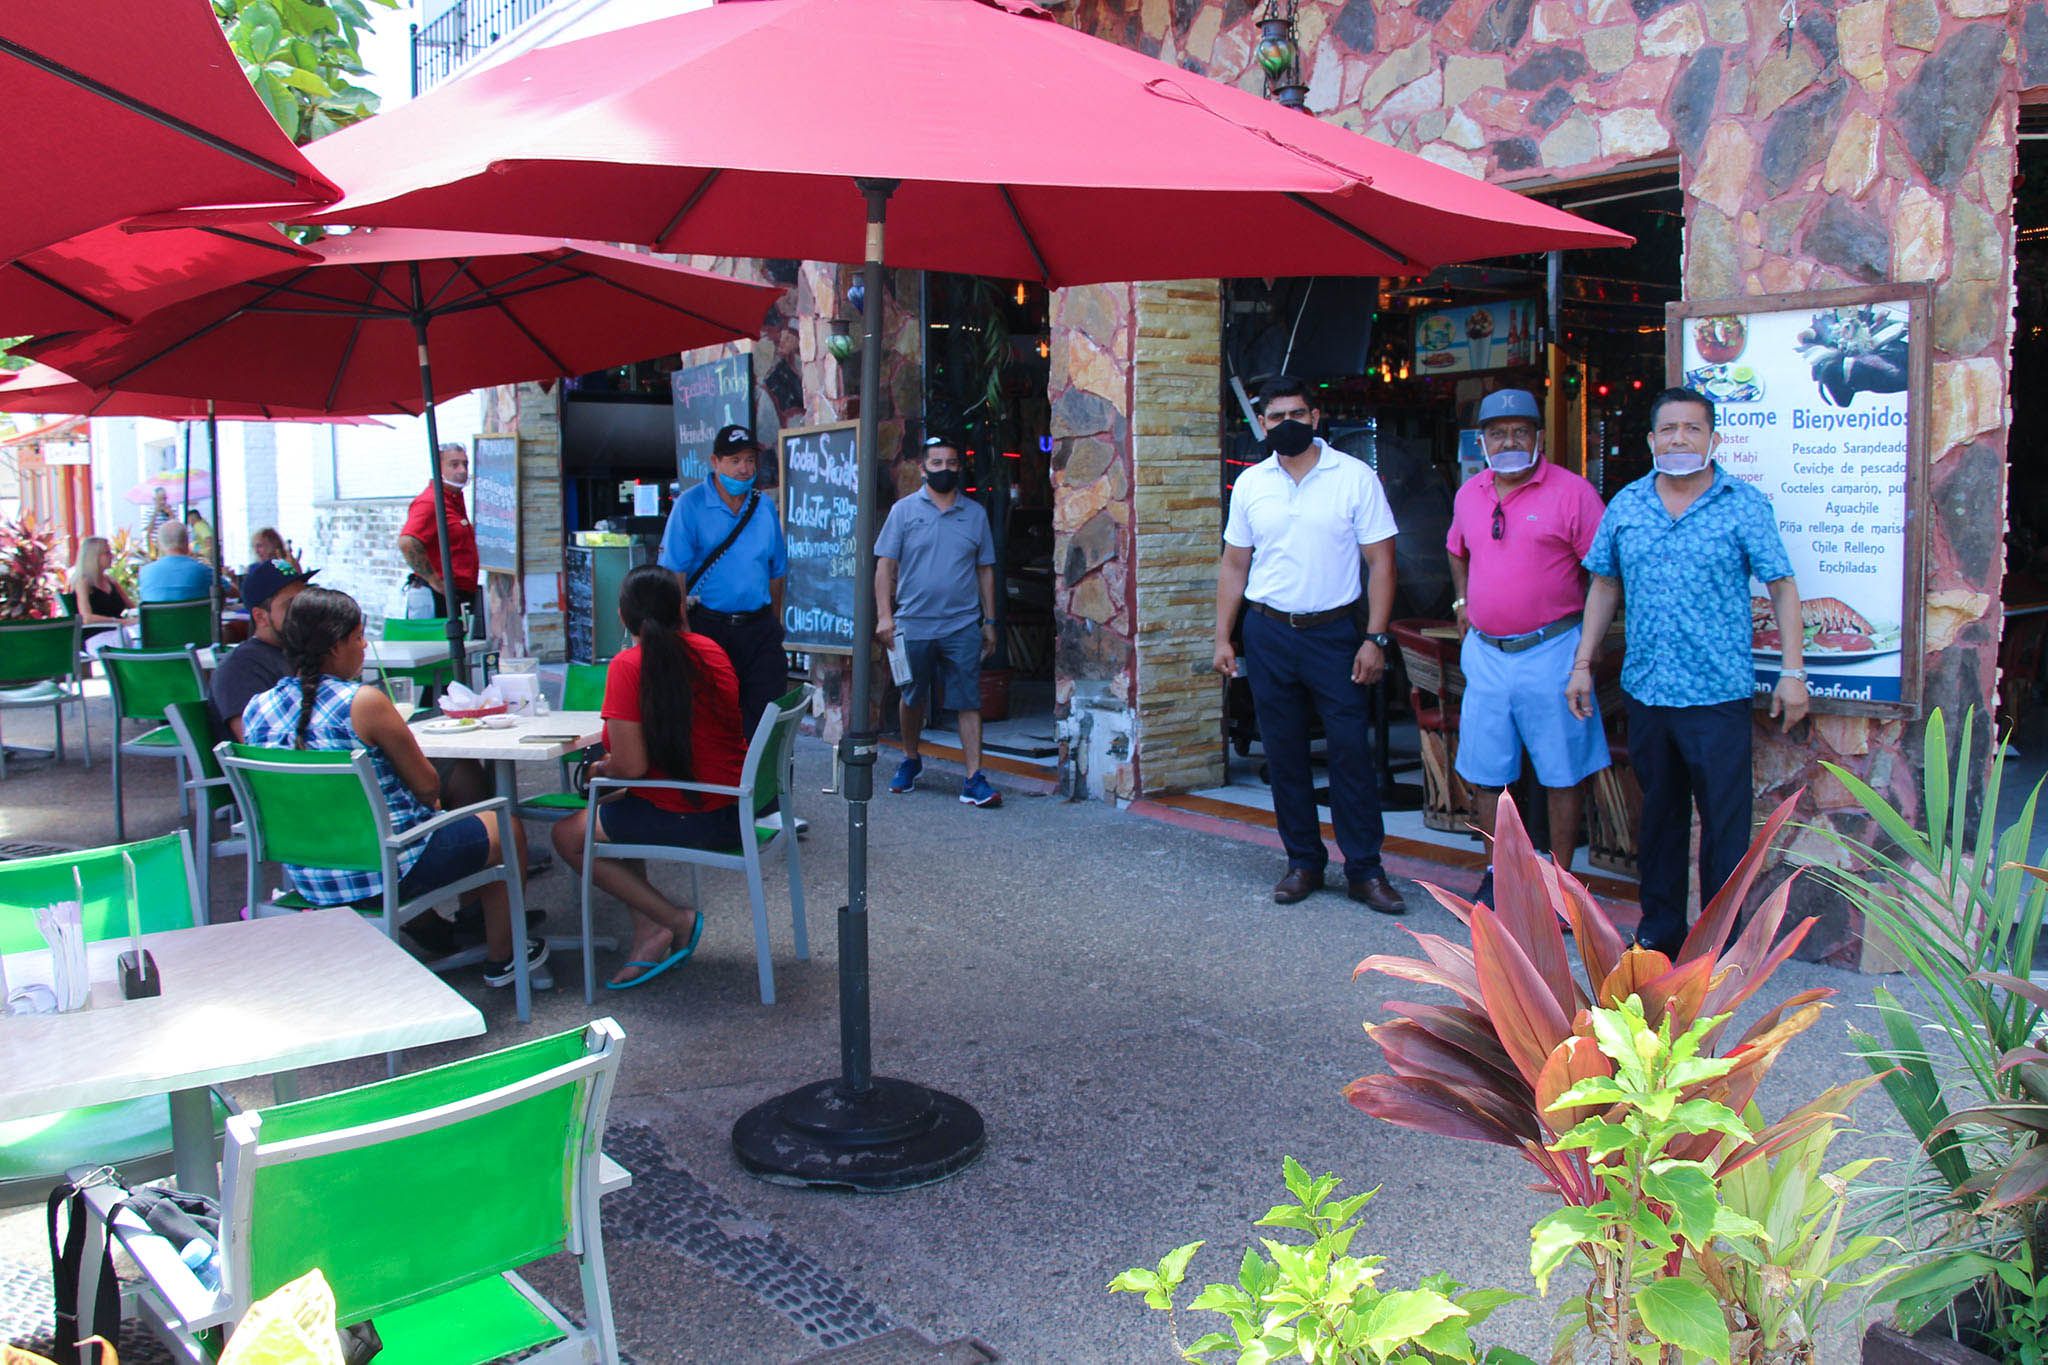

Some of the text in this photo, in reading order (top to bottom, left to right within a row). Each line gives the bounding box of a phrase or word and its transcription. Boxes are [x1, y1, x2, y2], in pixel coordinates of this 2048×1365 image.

[1714, 407, 1777, 428] elcome
[1719, 433, 1749, 444] bster
[1792, 442, 1837, 454] Pescado
[787, 438, 818, 483] Today
[1734, 452, 1758, 463] Mahi
[1794, 461, 1907, 477] Ceviche de pescado
[1781, 482, 1824, 494] Cocteles
[1825, 501, 1879, 516] Aguachile
[1780, 521, 1802, 533] Piña
[1809, 521, 1844, 534] rellena
[1851, 522, 1864, 533] de
[1812, 540, 1885, 555] Chile Relleno
[1819, 560, 1877, 574] Enchiladas
[1805, 681, 1871, 700] Seafood
